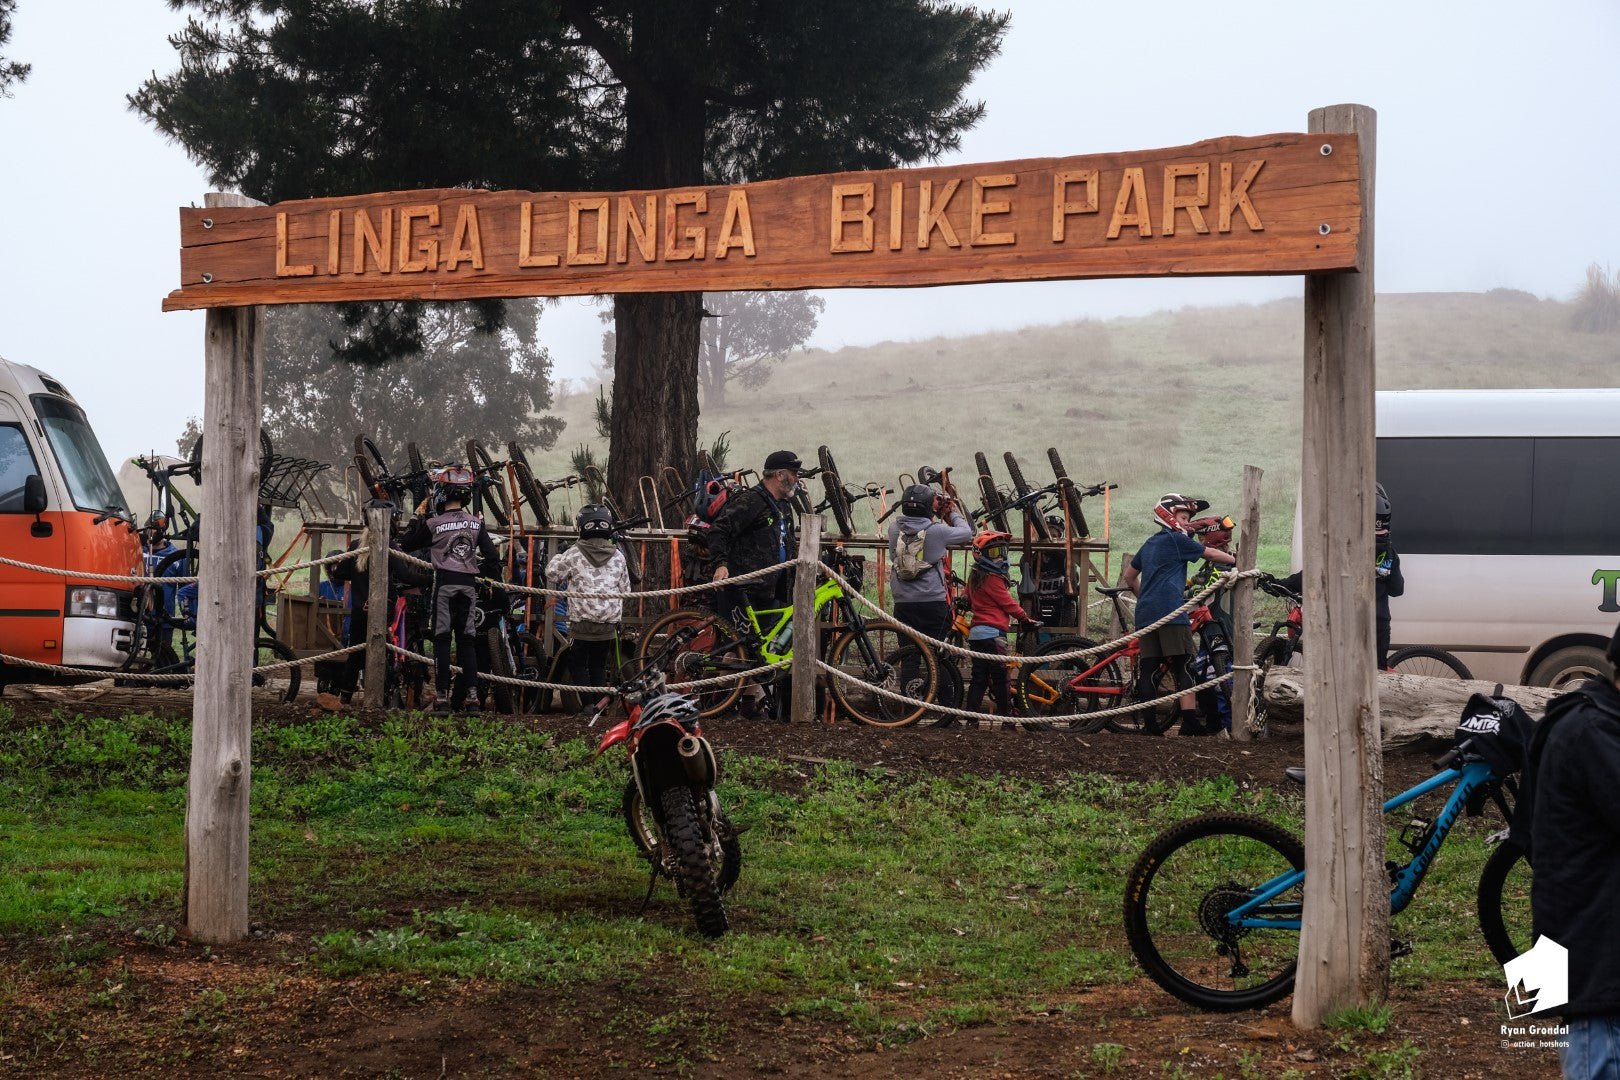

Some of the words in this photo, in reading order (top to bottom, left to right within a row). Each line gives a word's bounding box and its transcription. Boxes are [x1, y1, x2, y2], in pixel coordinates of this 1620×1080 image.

[274, 203, 484, 279] LINGA
[518, 188, 757, 268] LONGA
[830, 173, 1018, 254] BIKE
[1051, 159, 1265, 243] PARK
